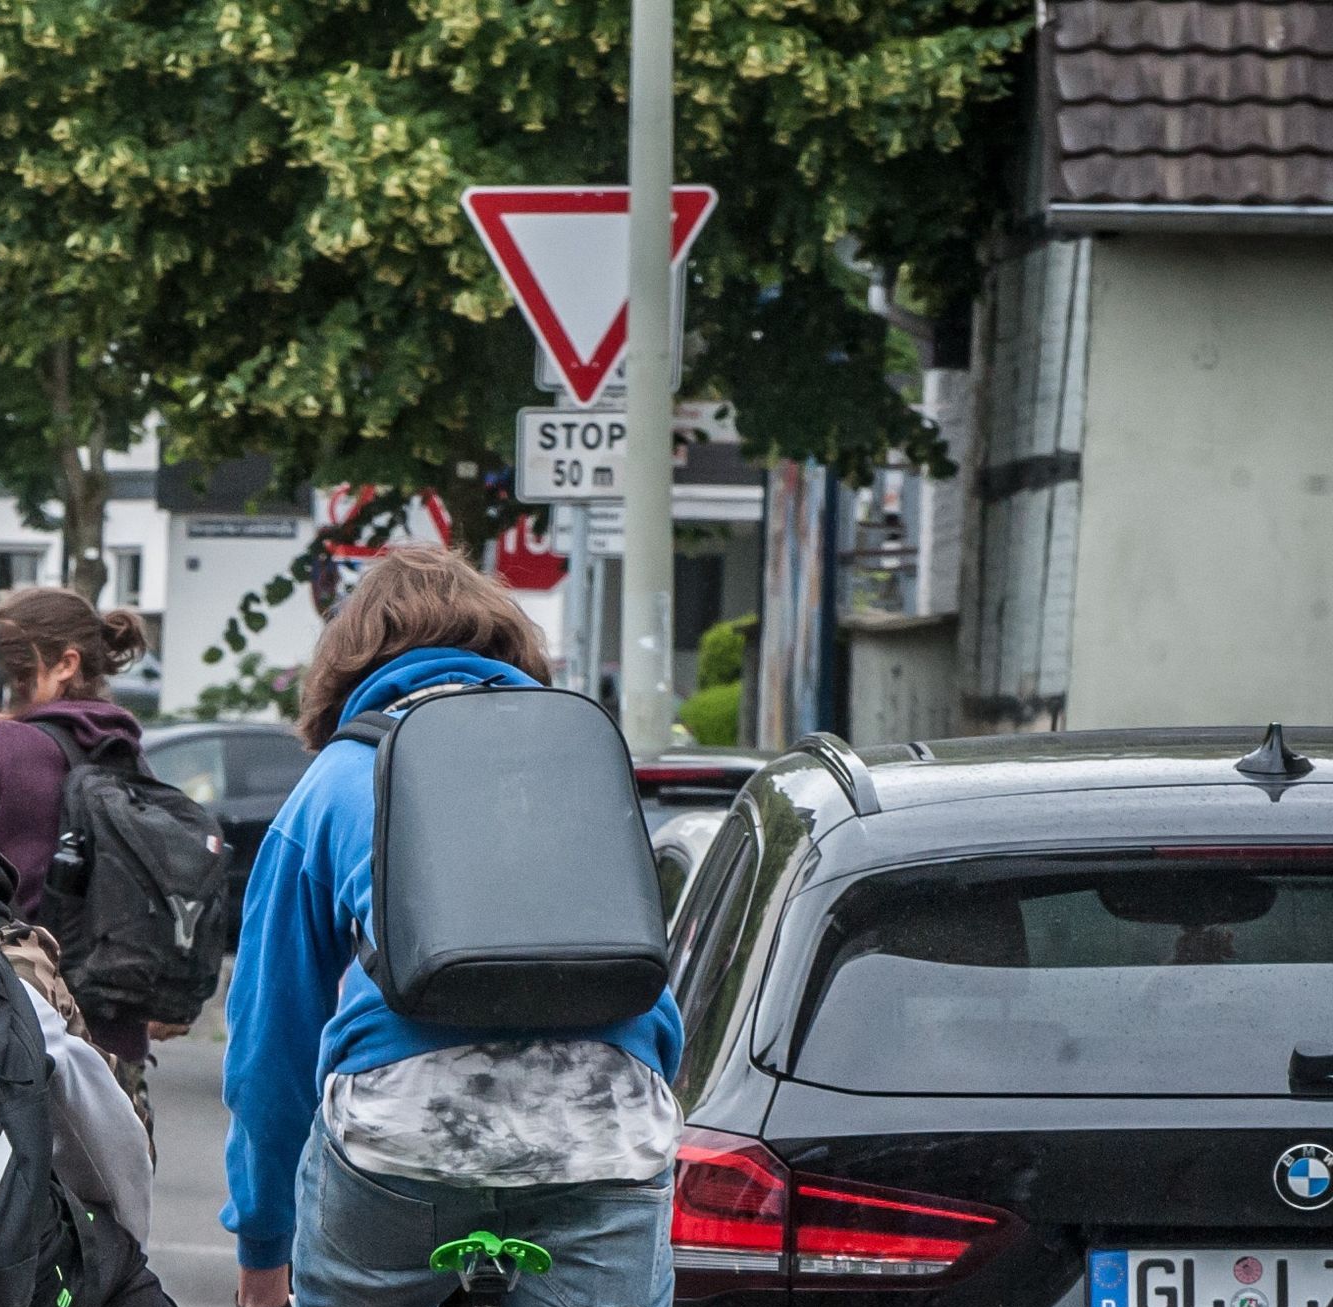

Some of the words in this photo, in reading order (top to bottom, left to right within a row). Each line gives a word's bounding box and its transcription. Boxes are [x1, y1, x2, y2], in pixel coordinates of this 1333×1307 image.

[539, 422, 626, 450] STOP
[552, 460, 583, 487] 50
[592, 466, 614, 486] m
